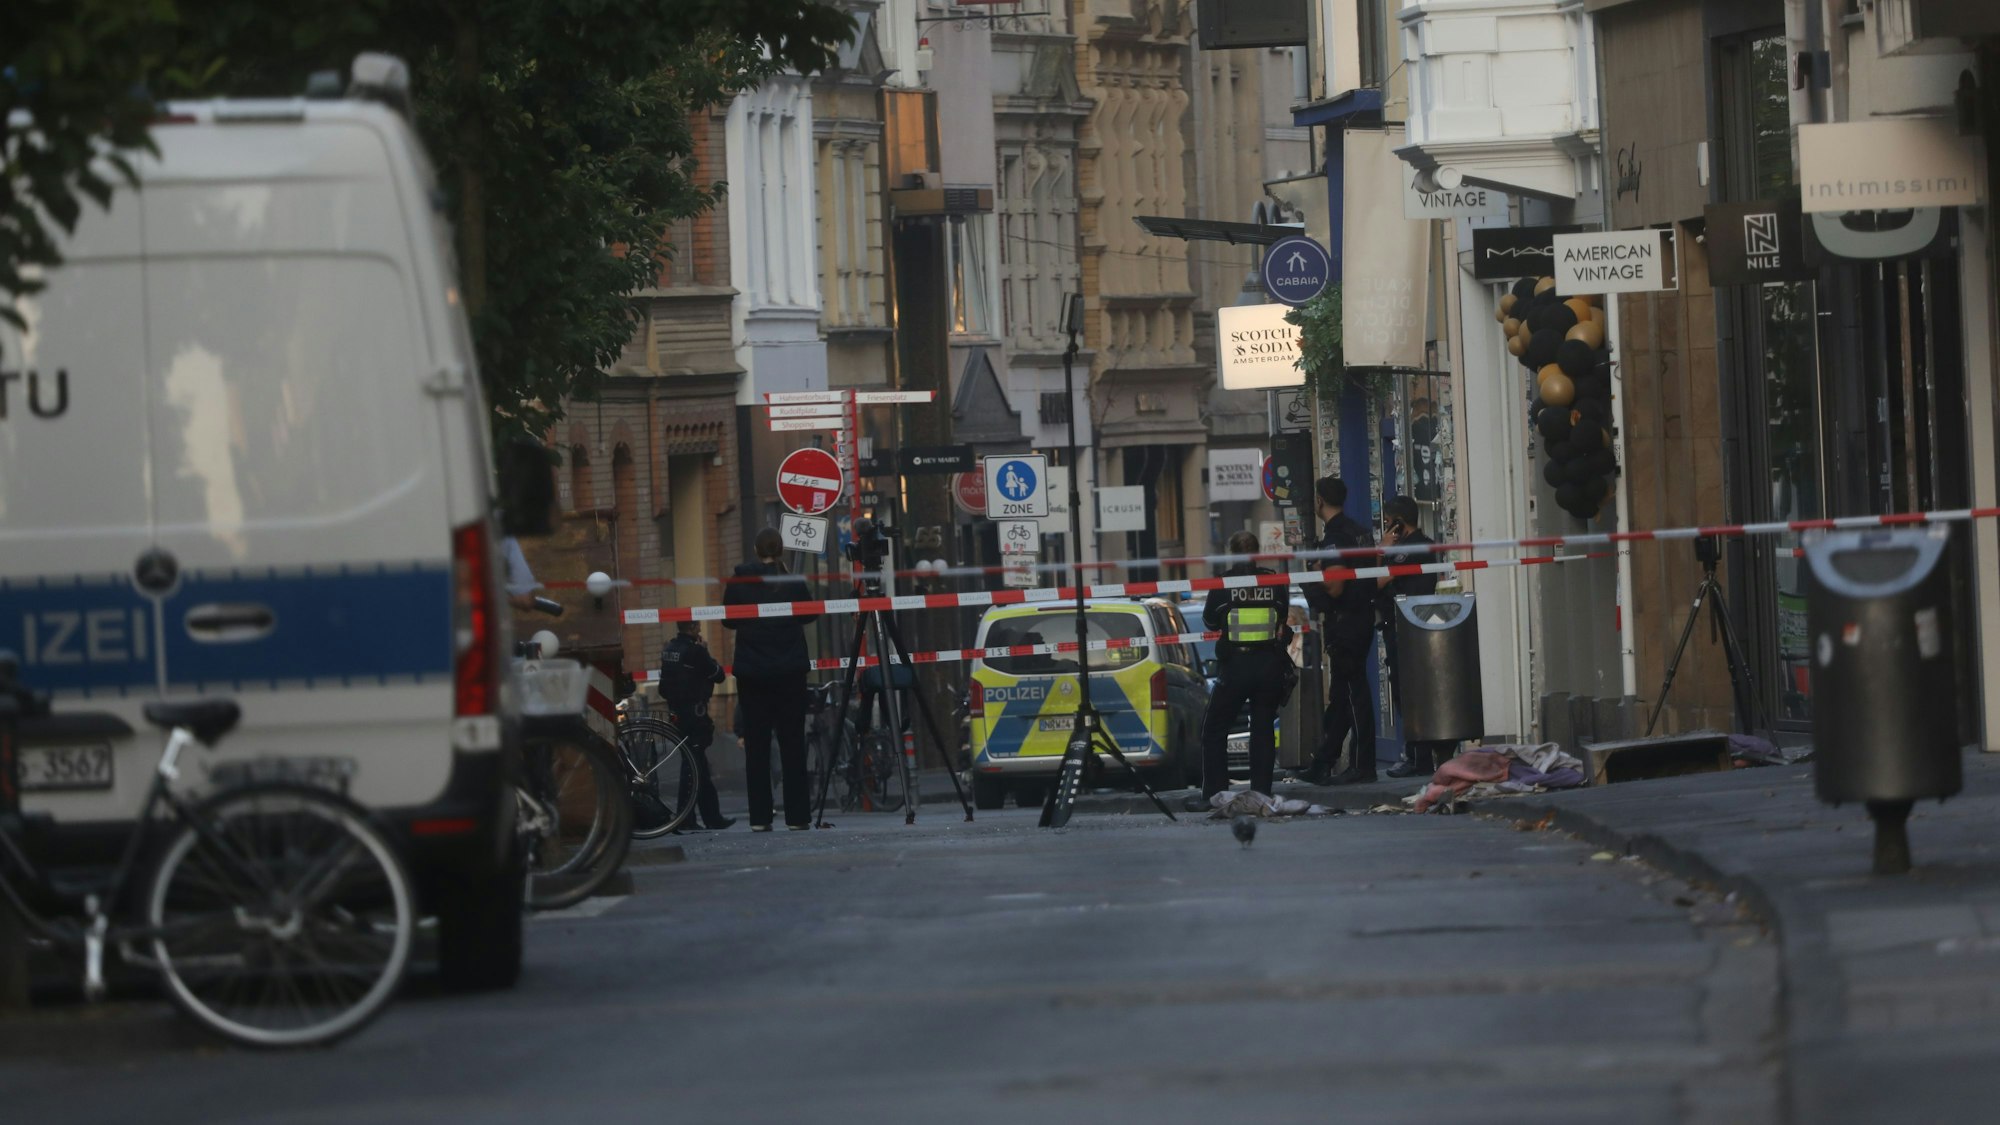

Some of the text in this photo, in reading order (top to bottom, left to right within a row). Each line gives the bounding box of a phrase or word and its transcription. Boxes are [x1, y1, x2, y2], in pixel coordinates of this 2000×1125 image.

[1810, 178, 1967, 197] intimissimi
[1419, 192, 1487, 208] VINTAGE
[1563, 244, 1652, 263] AMERICAN
[1746, 256, 1781, 269] NILE
[1573, 265, 1644, 281] VINTAGE
[1276, 276, 1319, 287] CABAIA
[1231, 327, 1292, 343] SCOTCH
[1250, 341, 1293, 355] SODA
[1233, 354, 1295, 364] AMSTERDAM
[781, 421, 815, 430] Shopping
[1003, 503, 1034, 515] ZONE
[794, 537, 809, 548] frei
[1231, 587, 1274, 601] POLIZEI
[24, 608, 147, 665] IZEI
[985, 686, 1045, 701] POLIZEI
